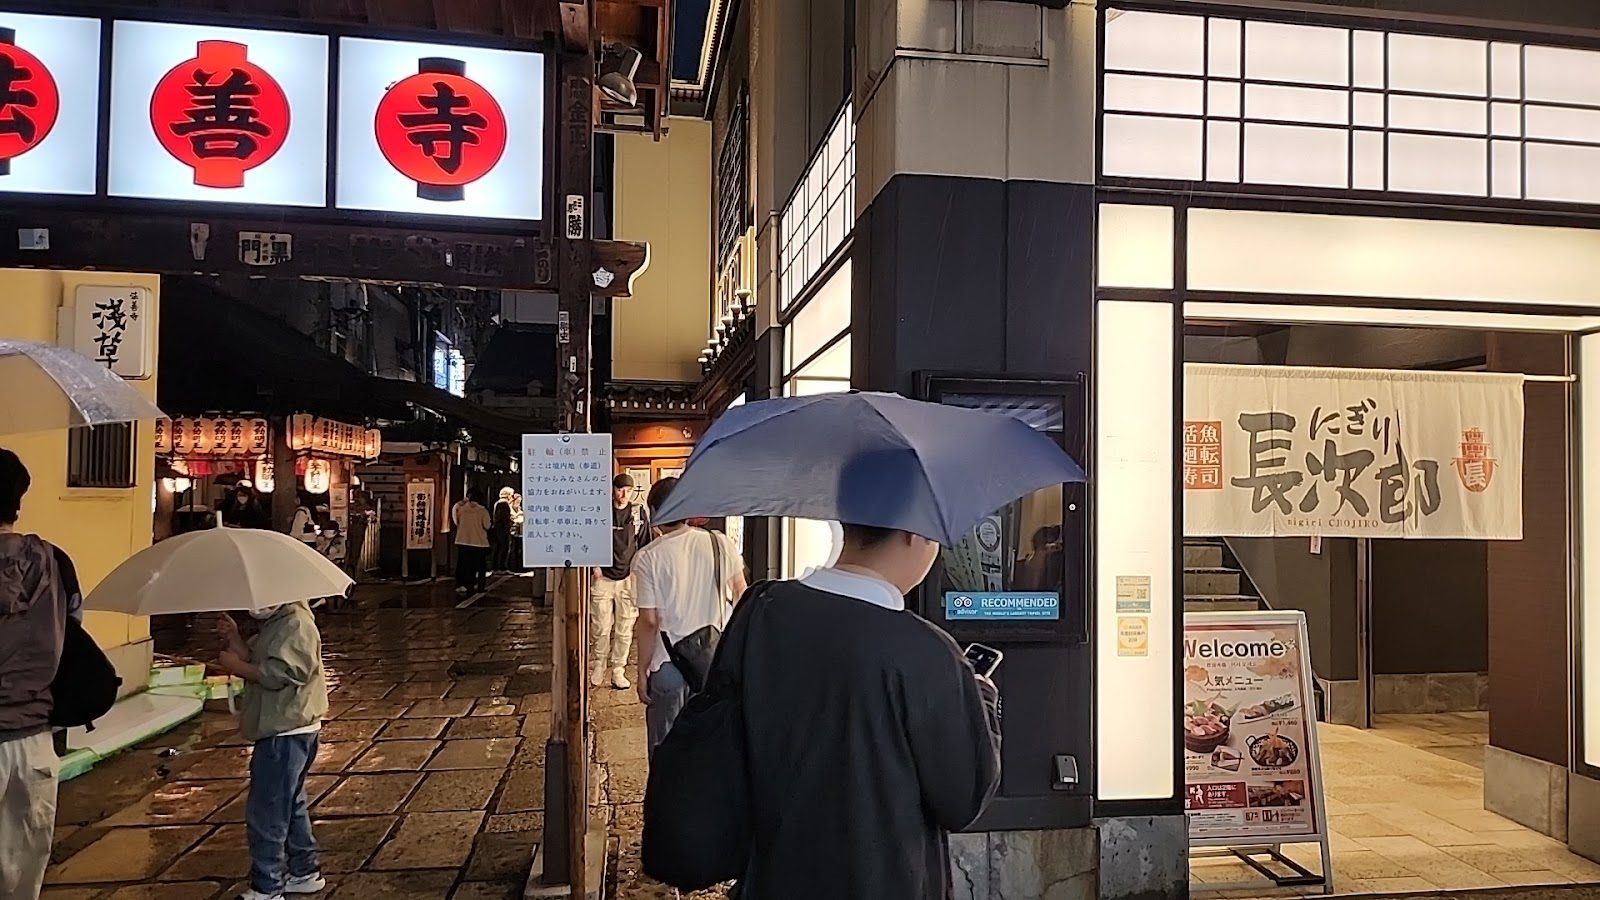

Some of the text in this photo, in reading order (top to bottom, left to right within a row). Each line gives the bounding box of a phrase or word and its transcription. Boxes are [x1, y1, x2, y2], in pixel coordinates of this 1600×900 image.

[1309, 397, 1390, 454] にぎり
[1231, 411, 1442, 529] 長次郎
[527, 475, 607, 483] ですからみなさんのご
[527, 489, 607, 497] 協力をおねがいします。
[1328, 518, 1379, 529] CHOJIRO
[981, 598, 1057, 608] RECOMMENDED
[1204, 676, 1264, 687] 人気メニュー
